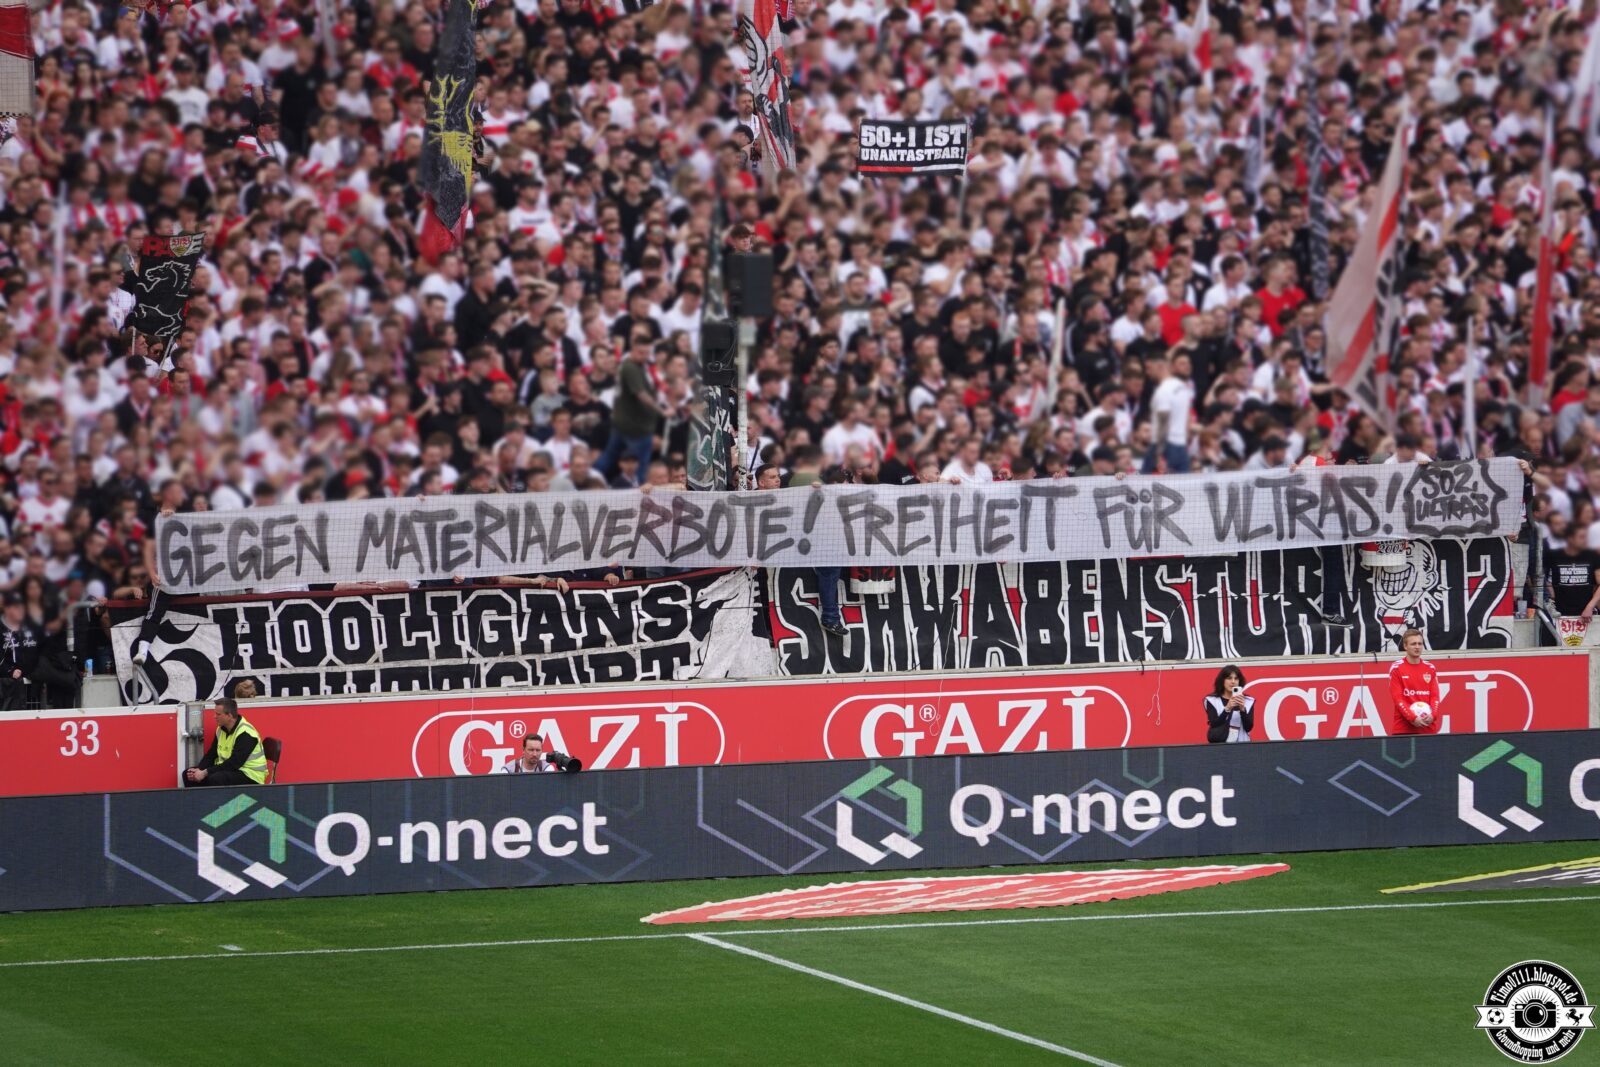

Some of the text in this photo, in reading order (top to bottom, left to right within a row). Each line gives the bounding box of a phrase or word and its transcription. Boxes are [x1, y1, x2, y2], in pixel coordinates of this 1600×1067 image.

[861, 124, 967, 148] 50+1 IST
[861, 147, 965, 162] UNANTASTBAR!
[160, 511, 330, 587] GEGEN
[355, 490, 825, 575] MATERIALVERBOTE!
[836, 484, 1078, 557] FREIHEIT
[1204, 471, 1404, 544] ULTRAS!
[1416, 494, 1489, 522] ULTRAS
[208, 581, 692, 671] HOOLIGANS
[60, 719, 100, 757] 33
[950, 775, 1237, 847] Q-nnect
[315, 802, 610, 876] Q-nnect
